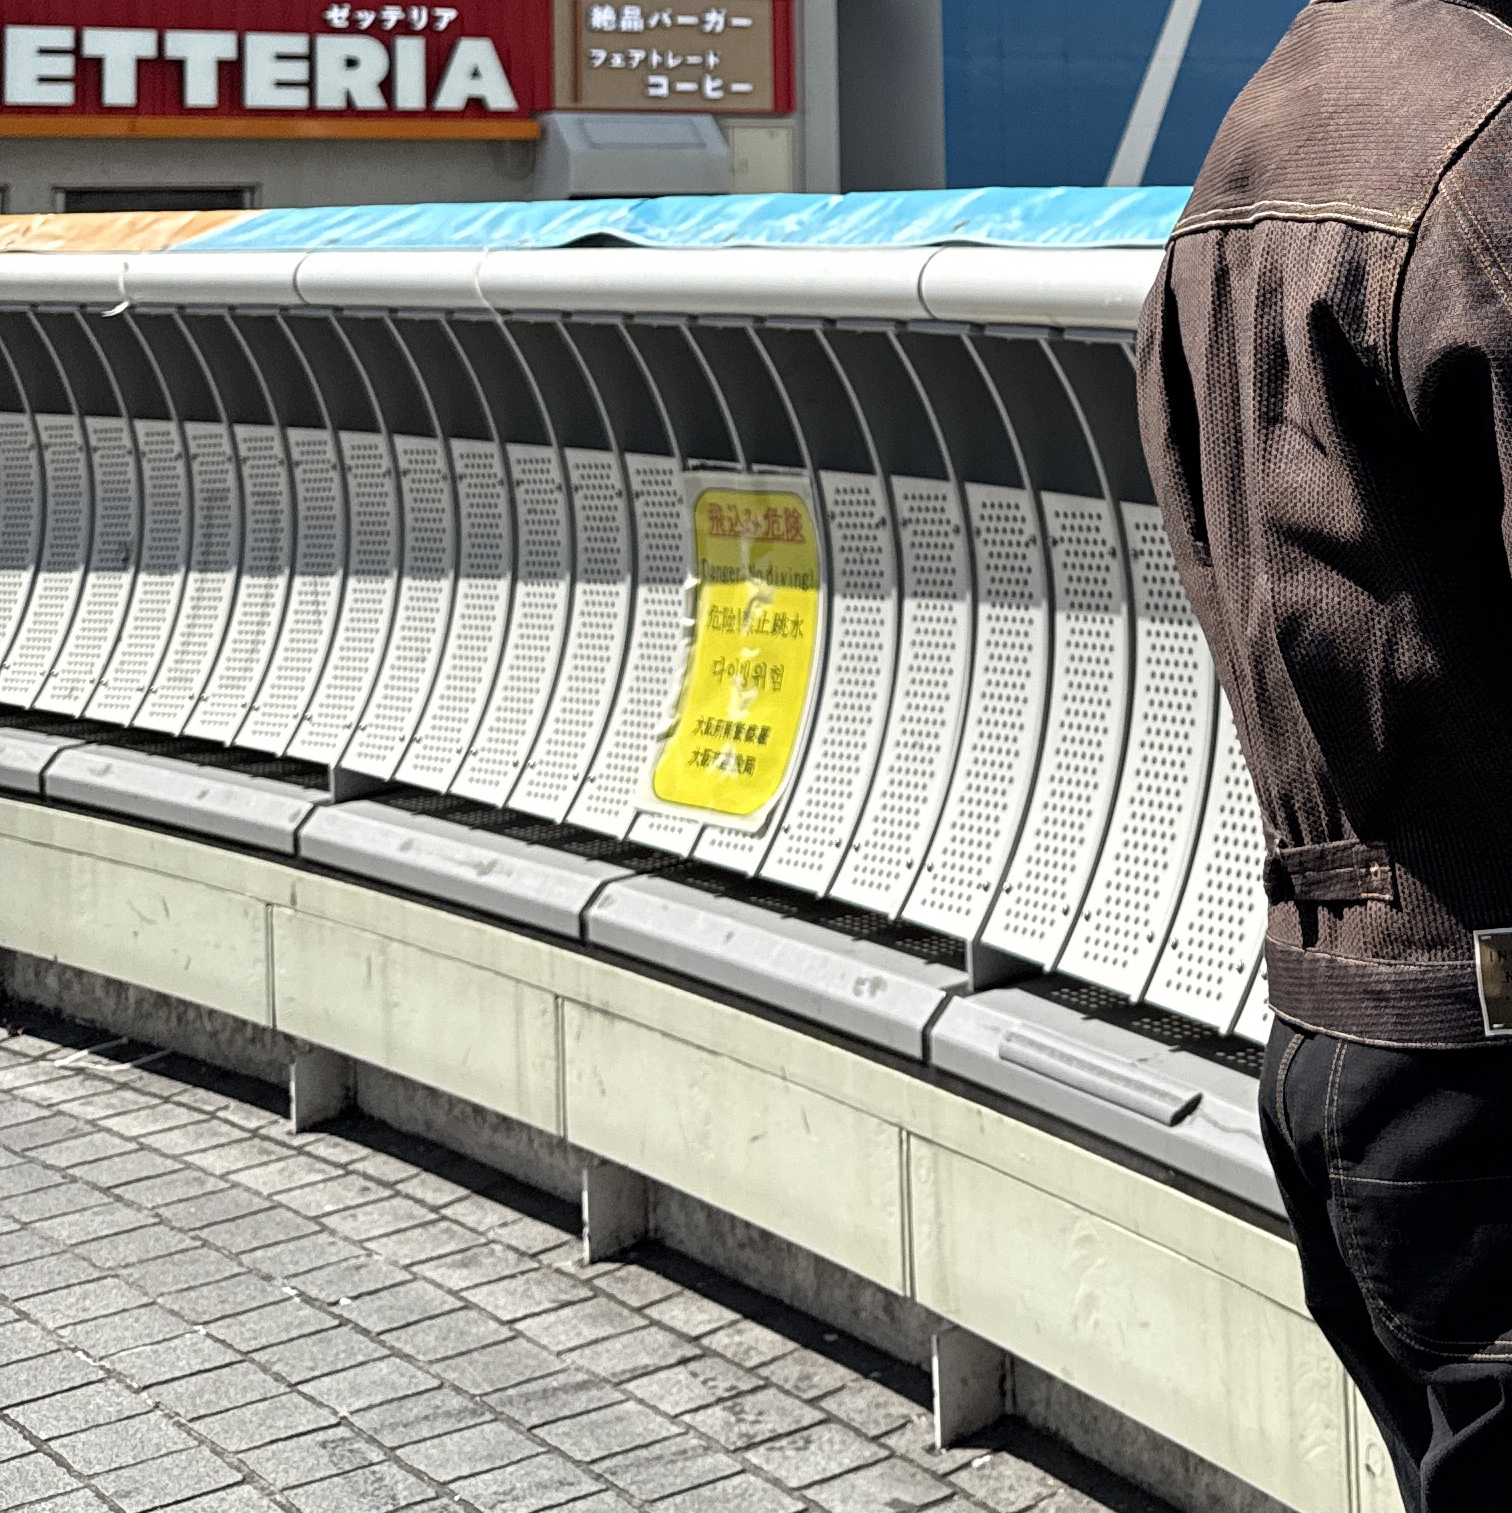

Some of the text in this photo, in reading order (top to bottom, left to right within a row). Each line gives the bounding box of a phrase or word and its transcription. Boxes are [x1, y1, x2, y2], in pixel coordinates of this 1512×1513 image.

[322, 2, 459, 32] ゼッテリア
[4, 26, 519, 113] ETTERIA
[588, 48, 720, 70] フェアトレード
[645, 74, 753, 100] コーヒー
